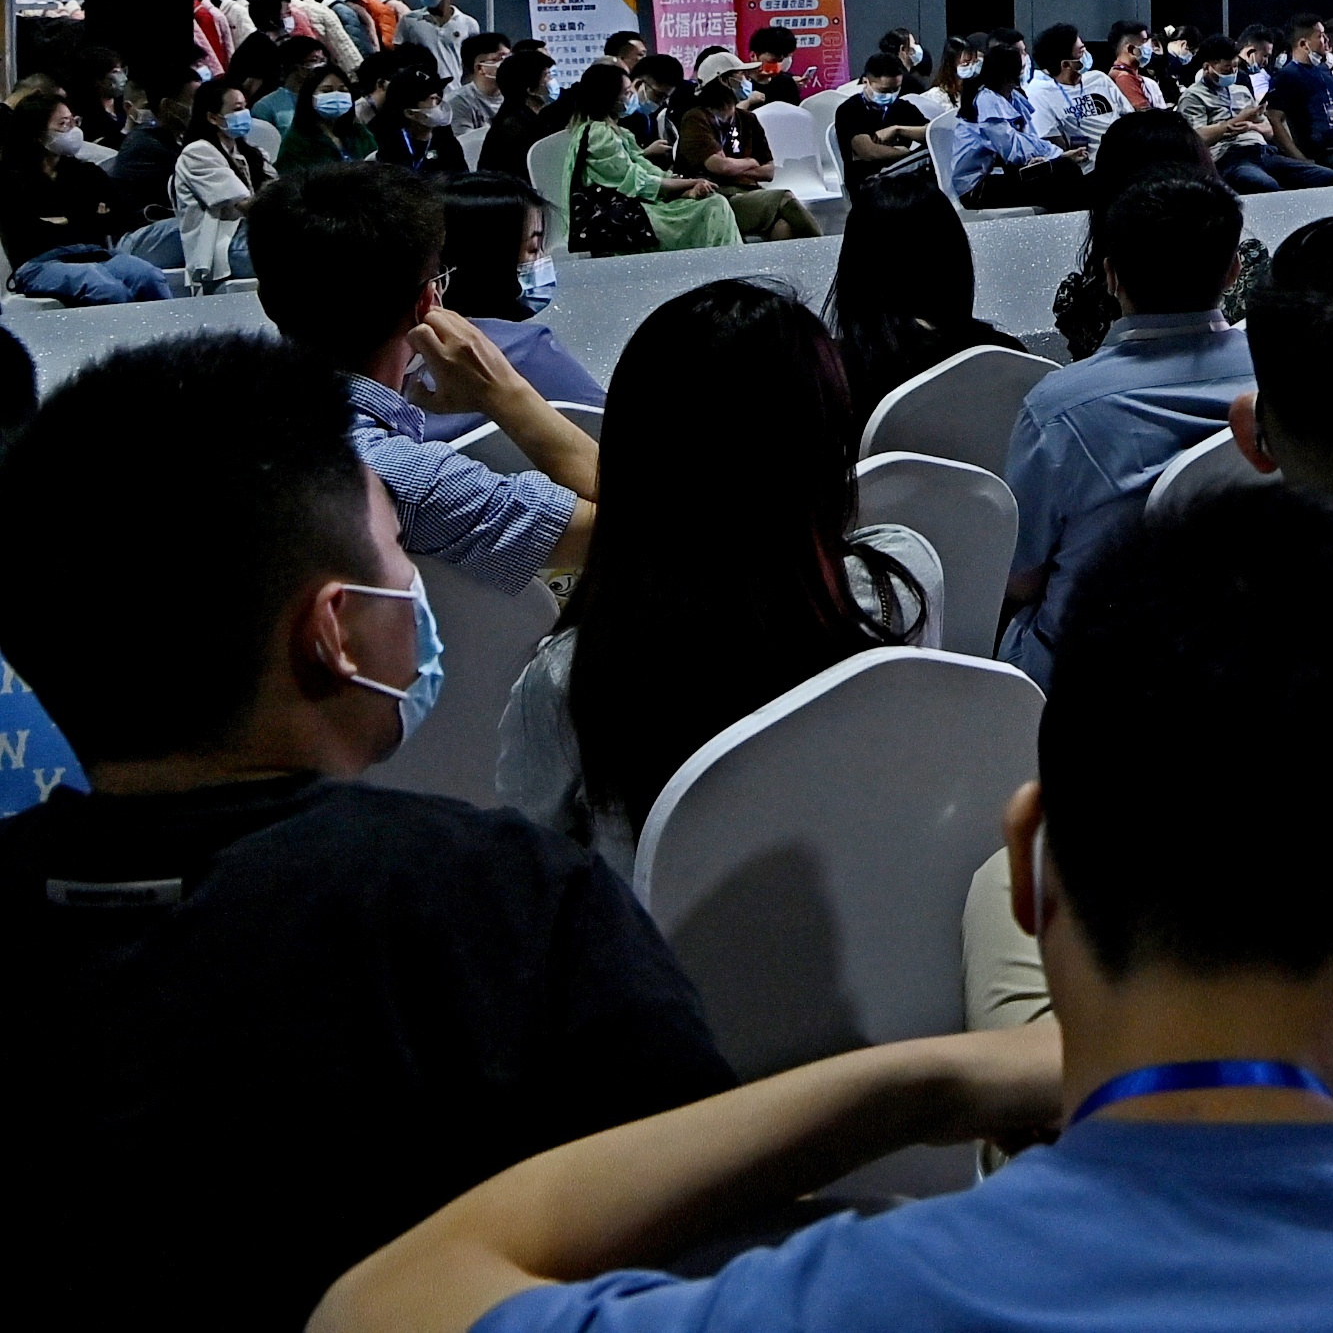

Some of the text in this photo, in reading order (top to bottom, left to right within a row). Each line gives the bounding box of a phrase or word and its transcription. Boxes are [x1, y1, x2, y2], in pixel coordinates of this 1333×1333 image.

[549, 22, 586, 32] 企业简介
[660, 12, 738, 38] 代播代运营
